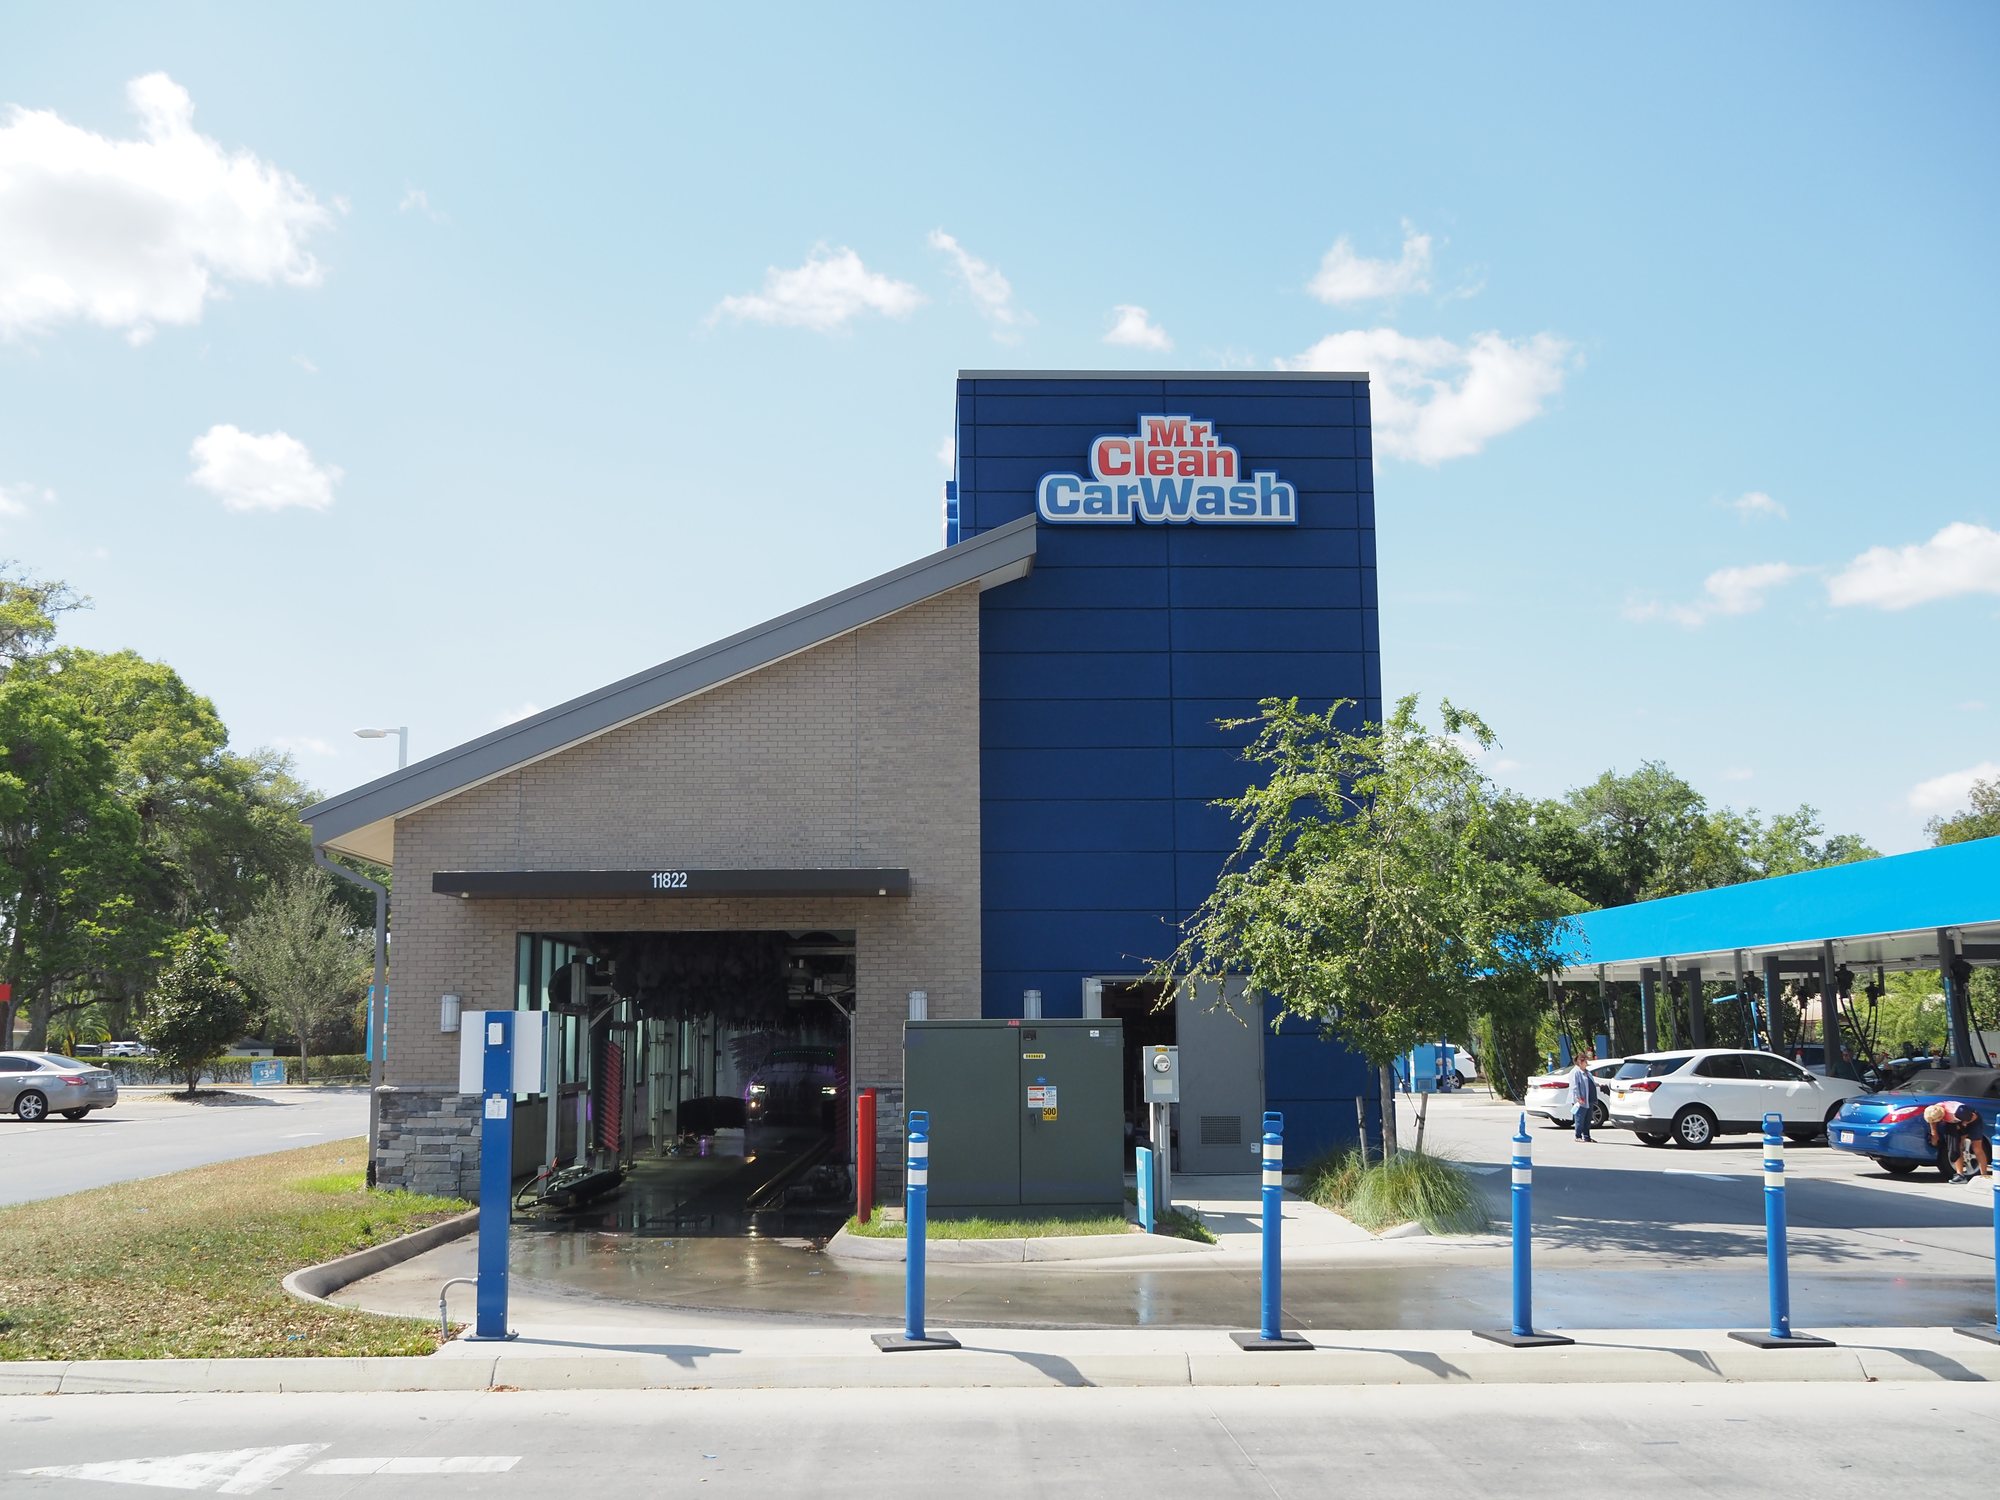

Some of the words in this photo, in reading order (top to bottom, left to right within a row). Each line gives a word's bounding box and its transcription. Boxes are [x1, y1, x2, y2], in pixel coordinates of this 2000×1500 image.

[1147, 419, 1215, 448] Mr.
[1097, 440, 1234, 478] Clean
[1045, 476, 1291, 516] CarWash
[651, 872, 688, 888] 11822
[1043, 1107, 1057, 1116] 500
